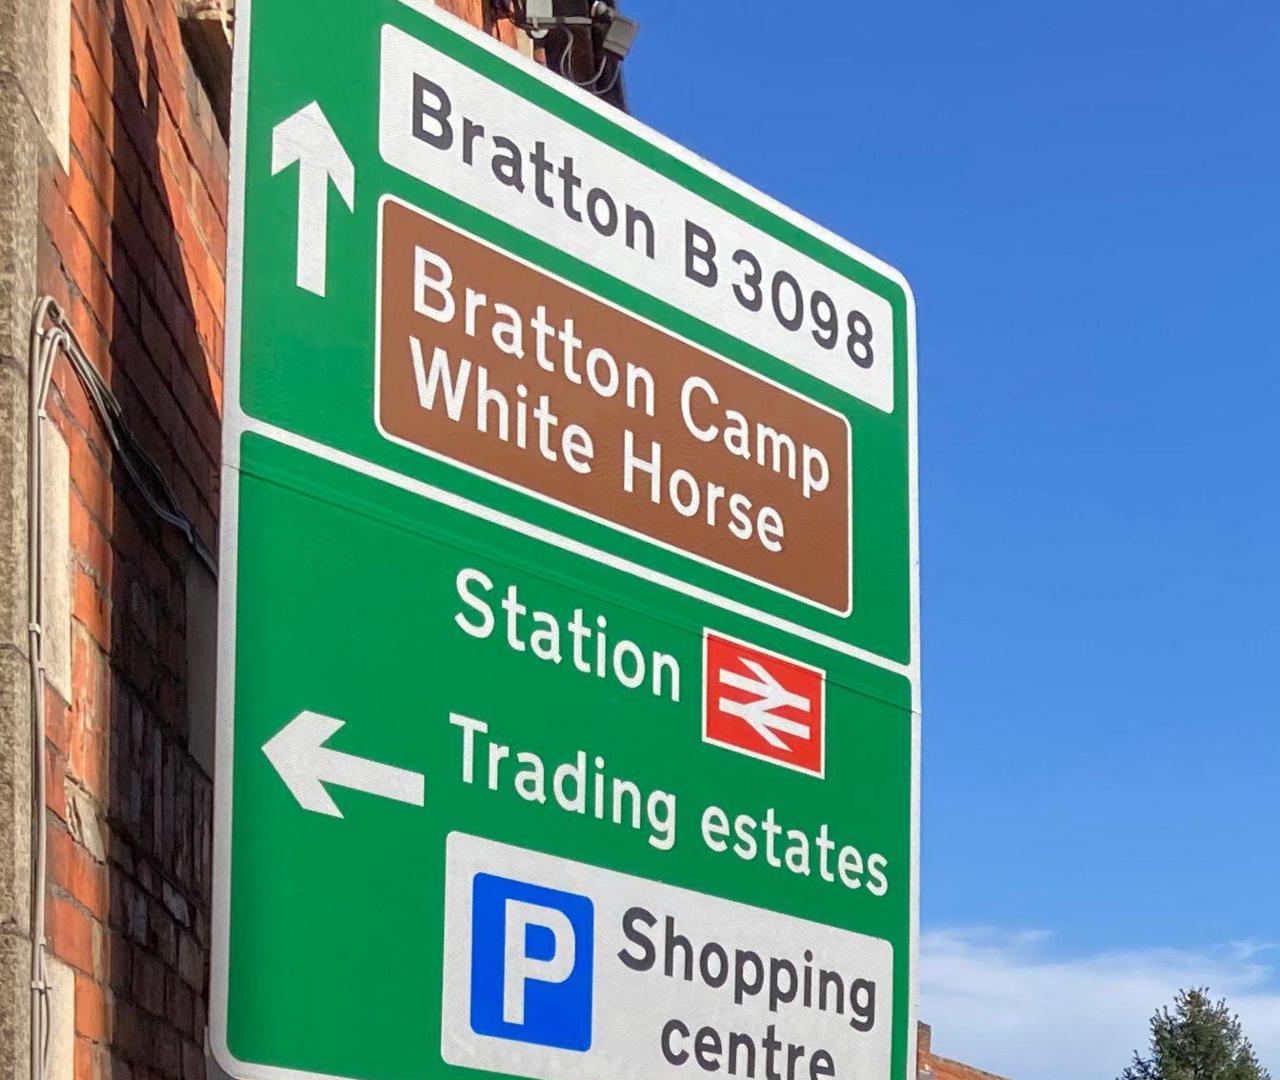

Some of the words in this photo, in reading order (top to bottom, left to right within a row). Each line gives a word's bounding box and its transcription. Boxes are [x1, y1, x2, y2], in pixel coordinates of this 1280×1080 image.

[411, 72, 655, 259] Bratton
[684, 220, 875, 370] B3098
[409, 336, 595, 474] White
[623, 429, 785, 553] Horse
[414, 245, 655, 417] Bratton
[681, 377, 830, 498] Camp
[455, 569, 681, 702] Station
[449, 713, 676, 850] Trading
[702, 805, 889, 896] estates
[502, 898, 577, 1025] P
[617, 907, 877, 1031] Shopping
